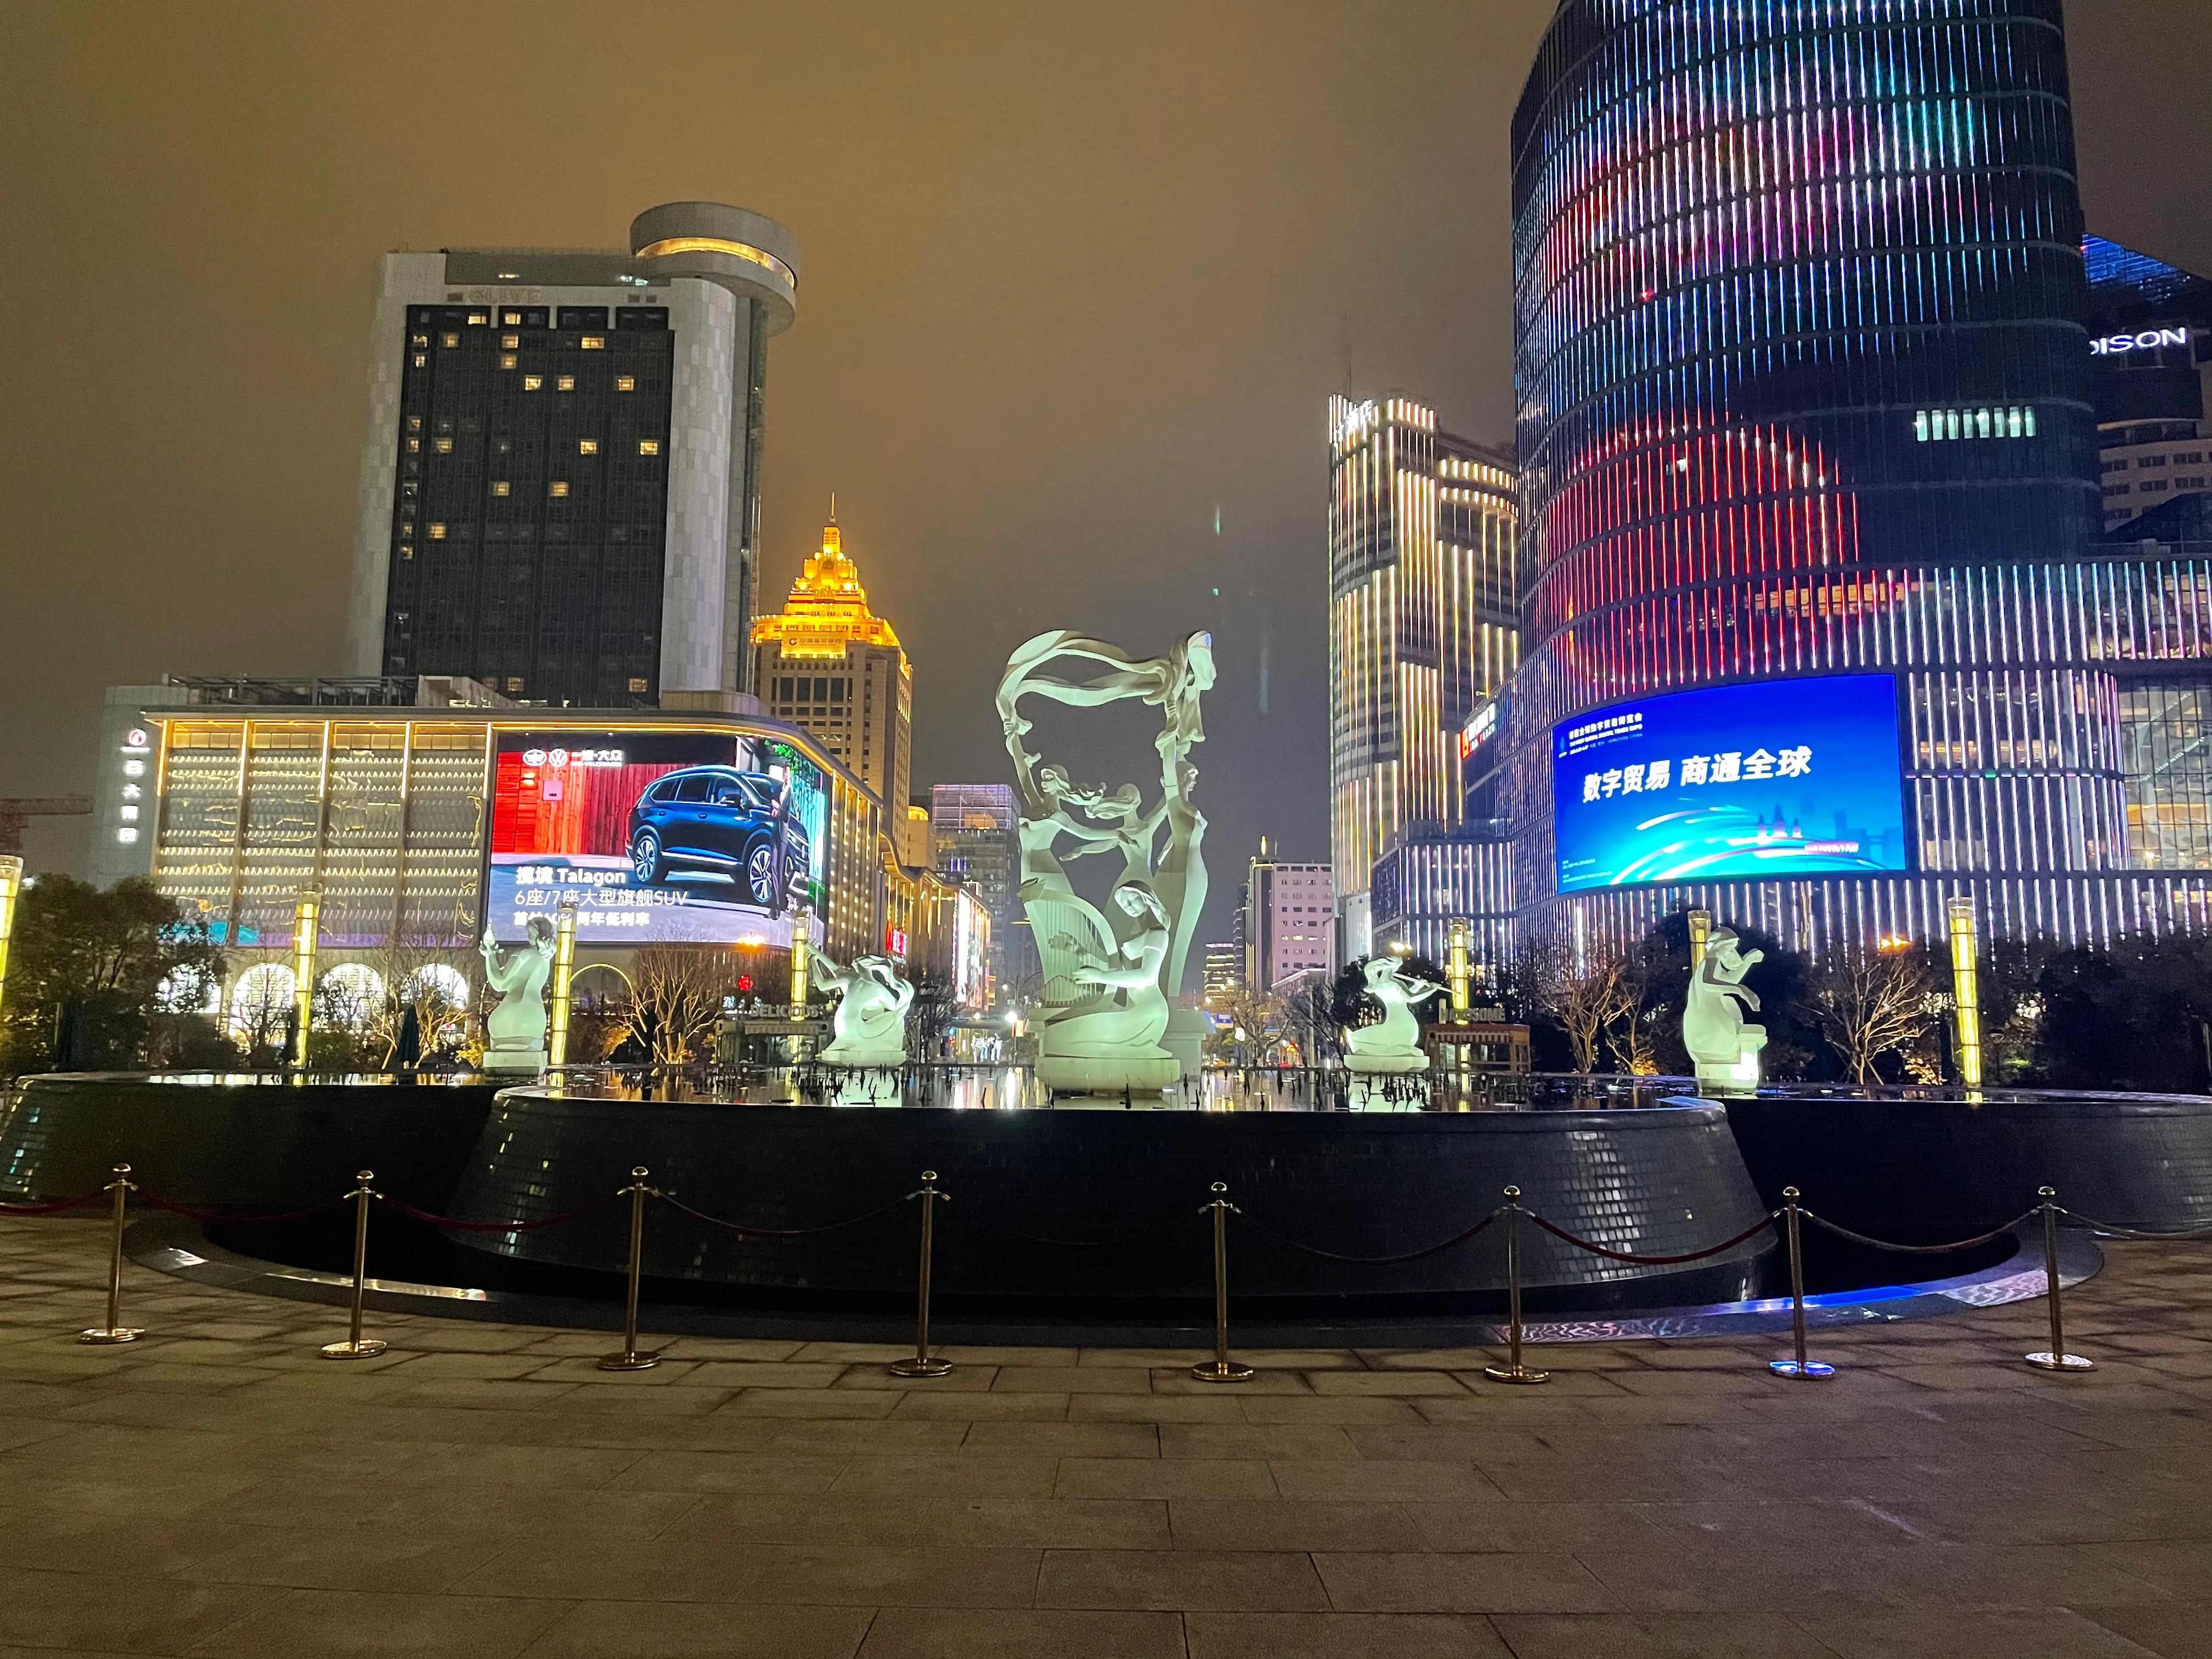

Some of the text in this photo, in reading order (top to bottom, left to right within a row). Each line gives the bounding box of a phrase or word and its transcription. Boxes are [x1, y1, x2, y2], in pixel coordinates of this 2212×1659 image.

[1583, 745, 1813, 803] 数字贸易 商通全球
[557, 868, 626, 887] Talagon
[515, 888, 688, 906] 6座/7座大型旗舰SUV
